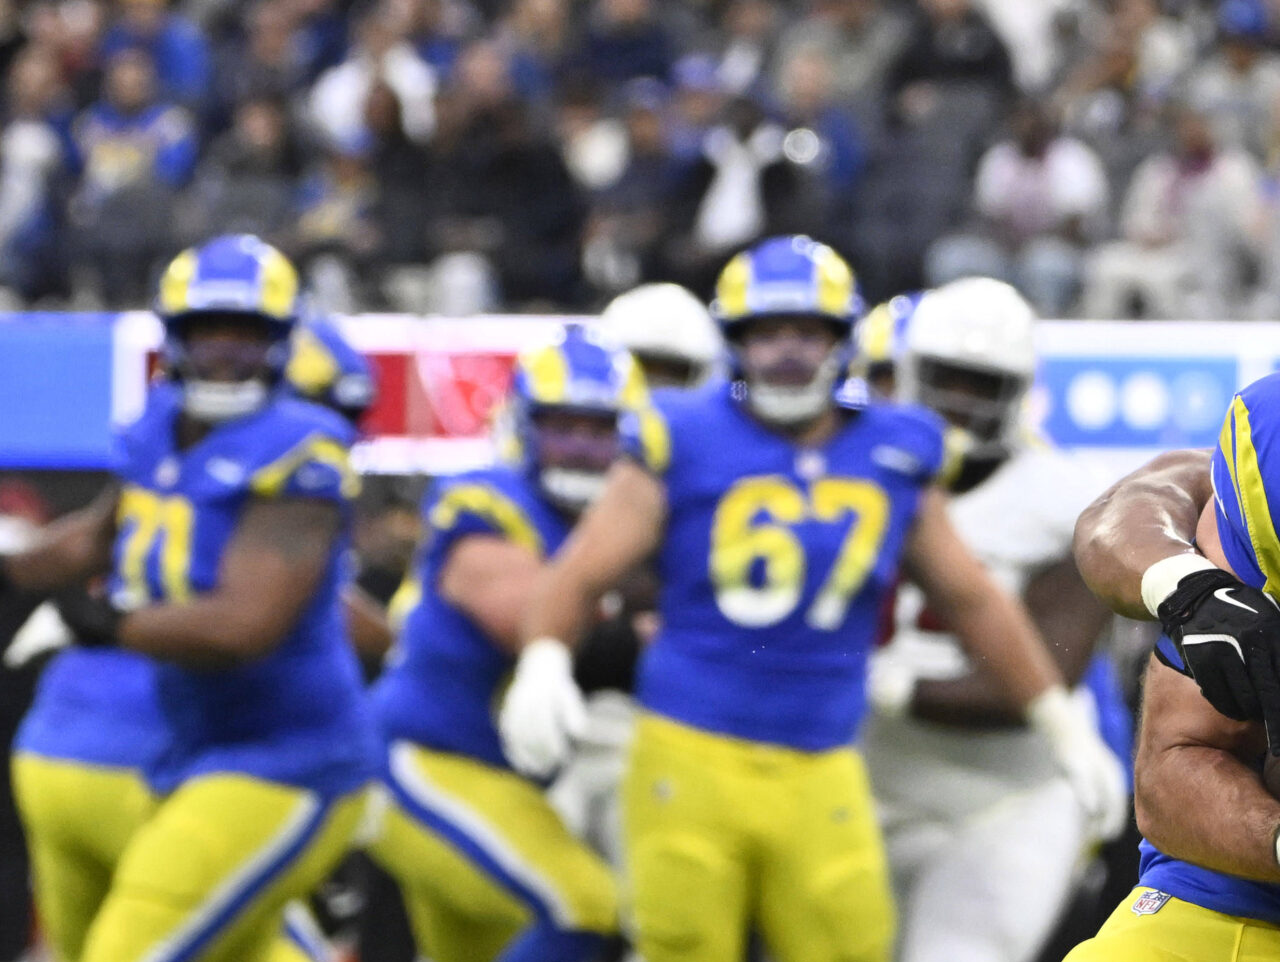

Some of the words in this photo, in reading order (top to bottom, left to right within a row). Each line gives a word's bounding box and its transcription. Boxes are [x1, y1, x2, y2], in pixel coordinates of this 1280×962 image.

[115, 484, 195, 612] 71
[711, 474, 891, 631] 67
[1137, 900, 1158, 910] NFL
